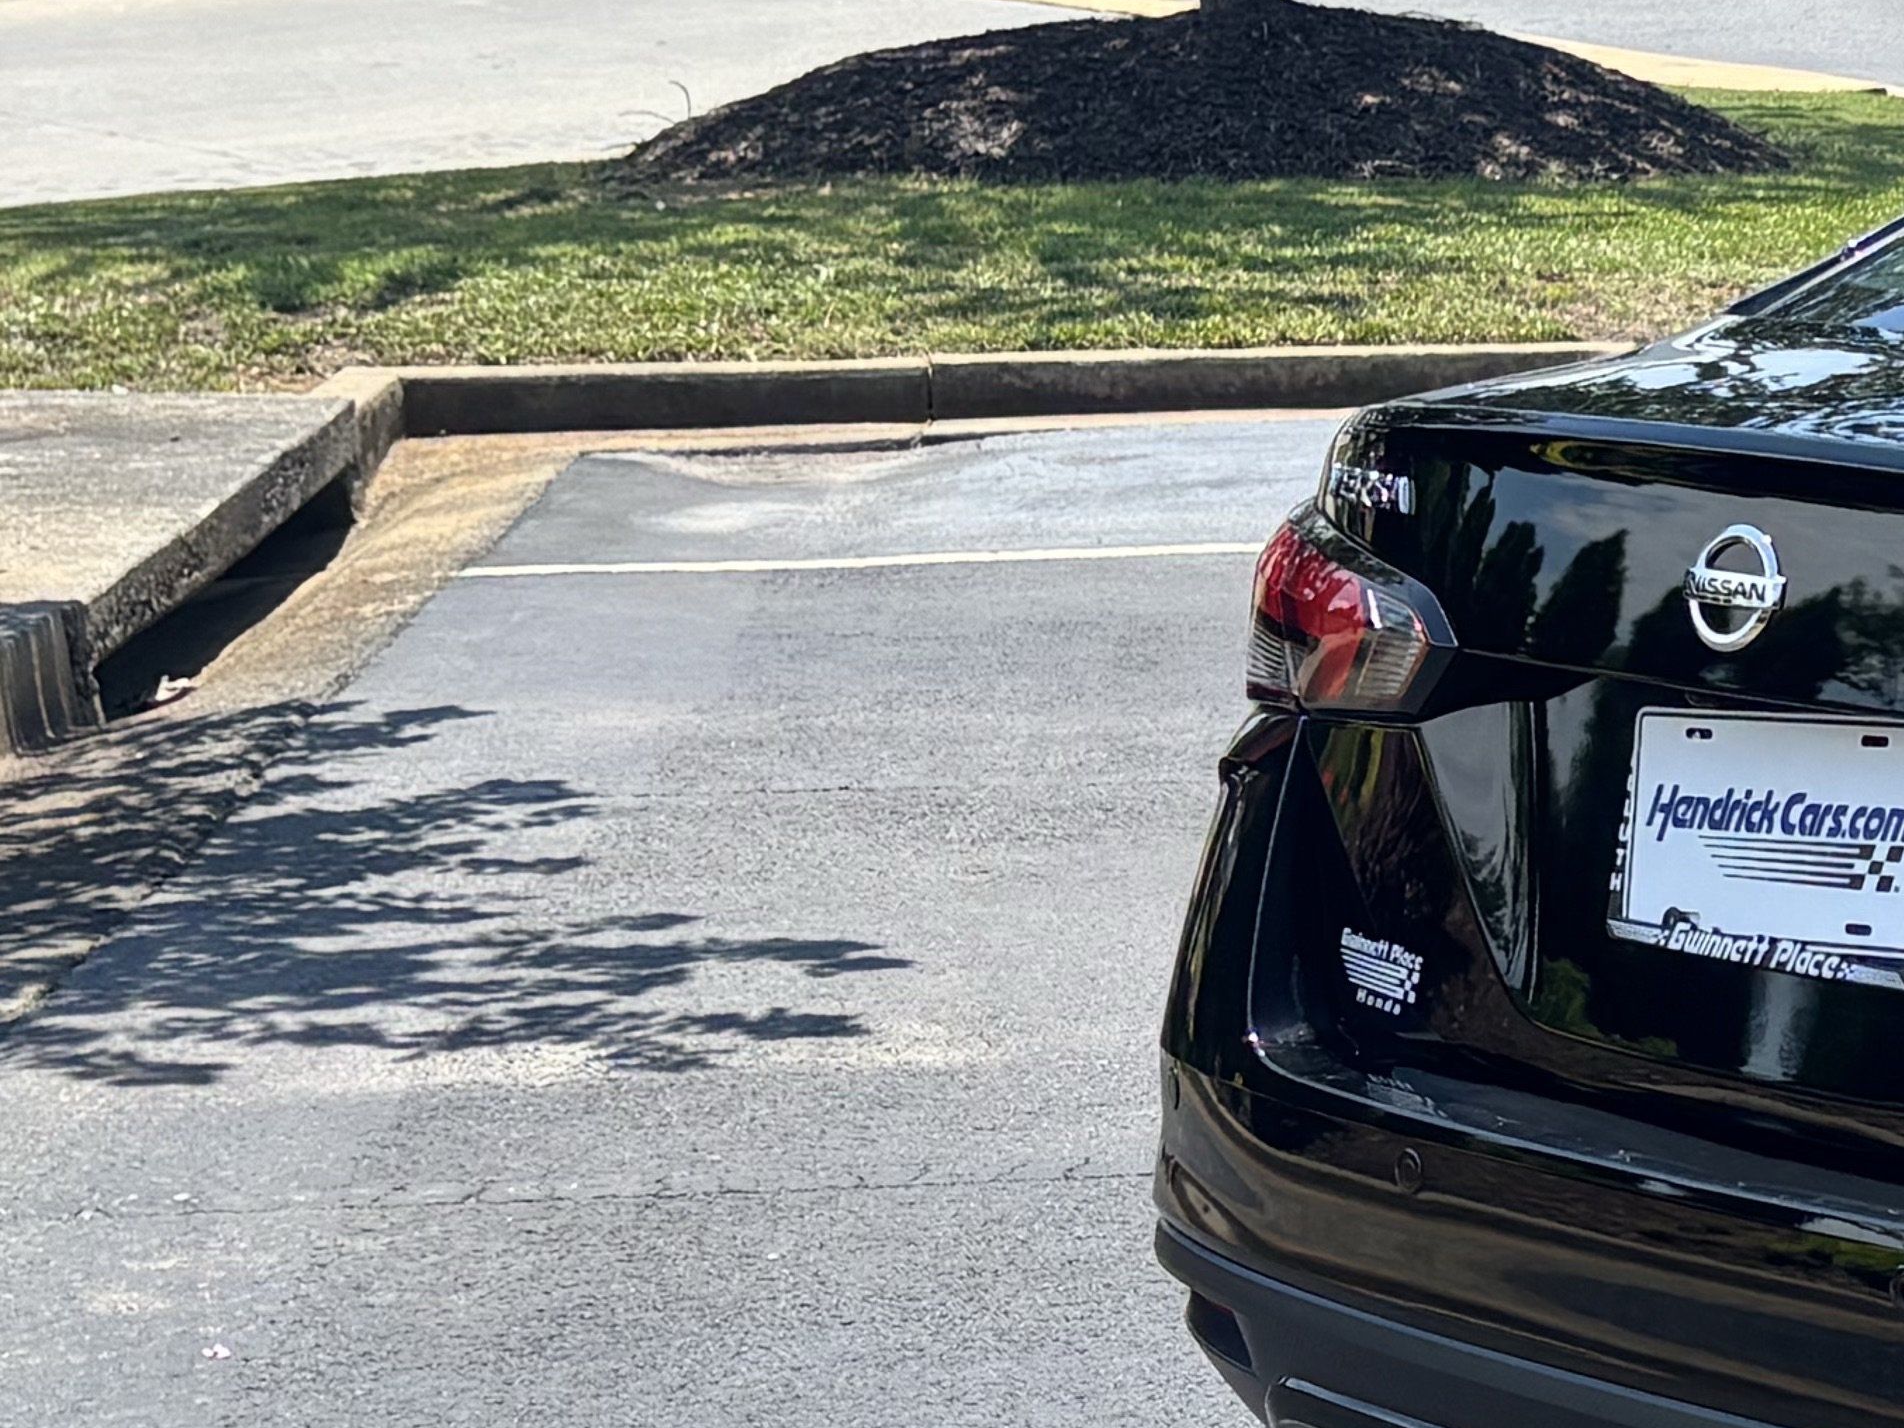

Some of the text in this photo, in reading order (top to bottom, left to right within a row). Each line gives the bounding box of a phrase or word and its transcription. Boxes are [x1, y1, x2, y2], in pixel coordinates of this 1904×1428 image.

[1686, 571, 1767, 604] NISSAN
[1668, 921, 1771, 966] Gwinnett
[1769, 939, 1841, 979] Place
